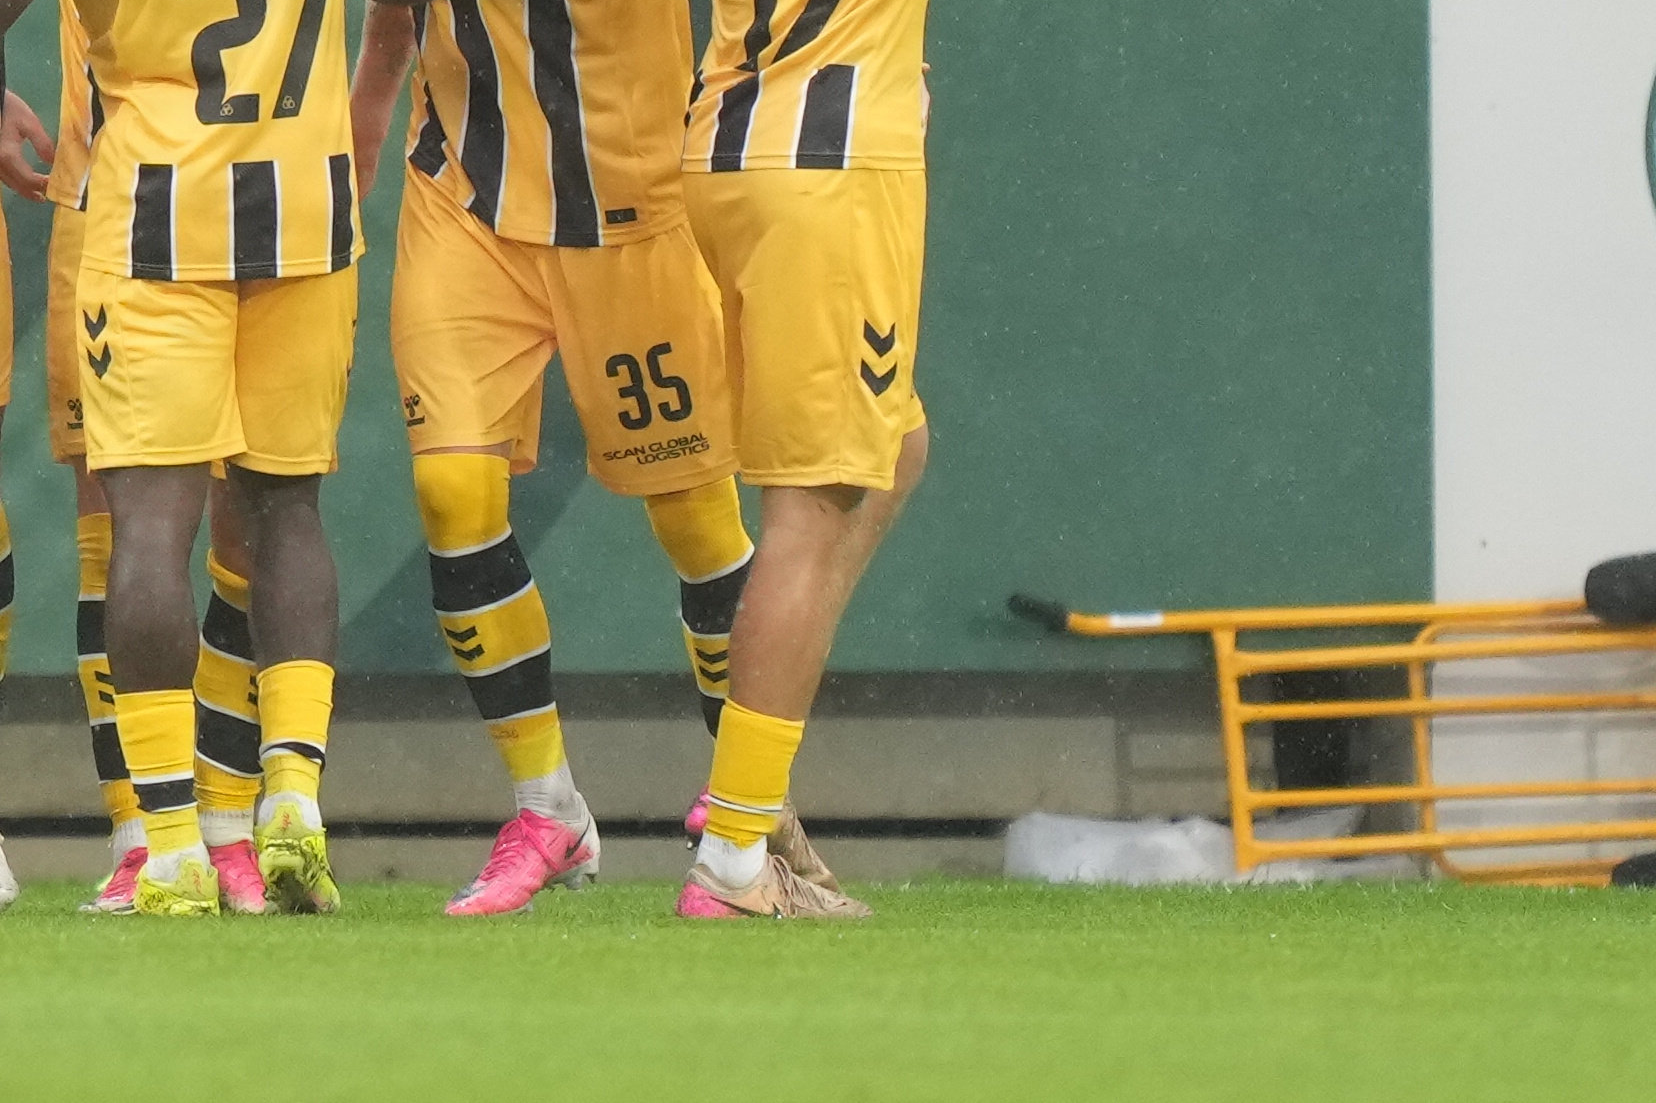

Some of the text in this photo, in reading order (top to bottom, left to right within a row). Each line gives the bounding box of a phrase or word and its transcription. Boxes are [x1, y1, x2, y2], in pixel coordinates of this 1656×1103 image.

[605, 341, 693, 431] 35
[603, 432, 708, 461] SCAN GLOBAL
[637, 441, 710, 464] LOGISTICS
